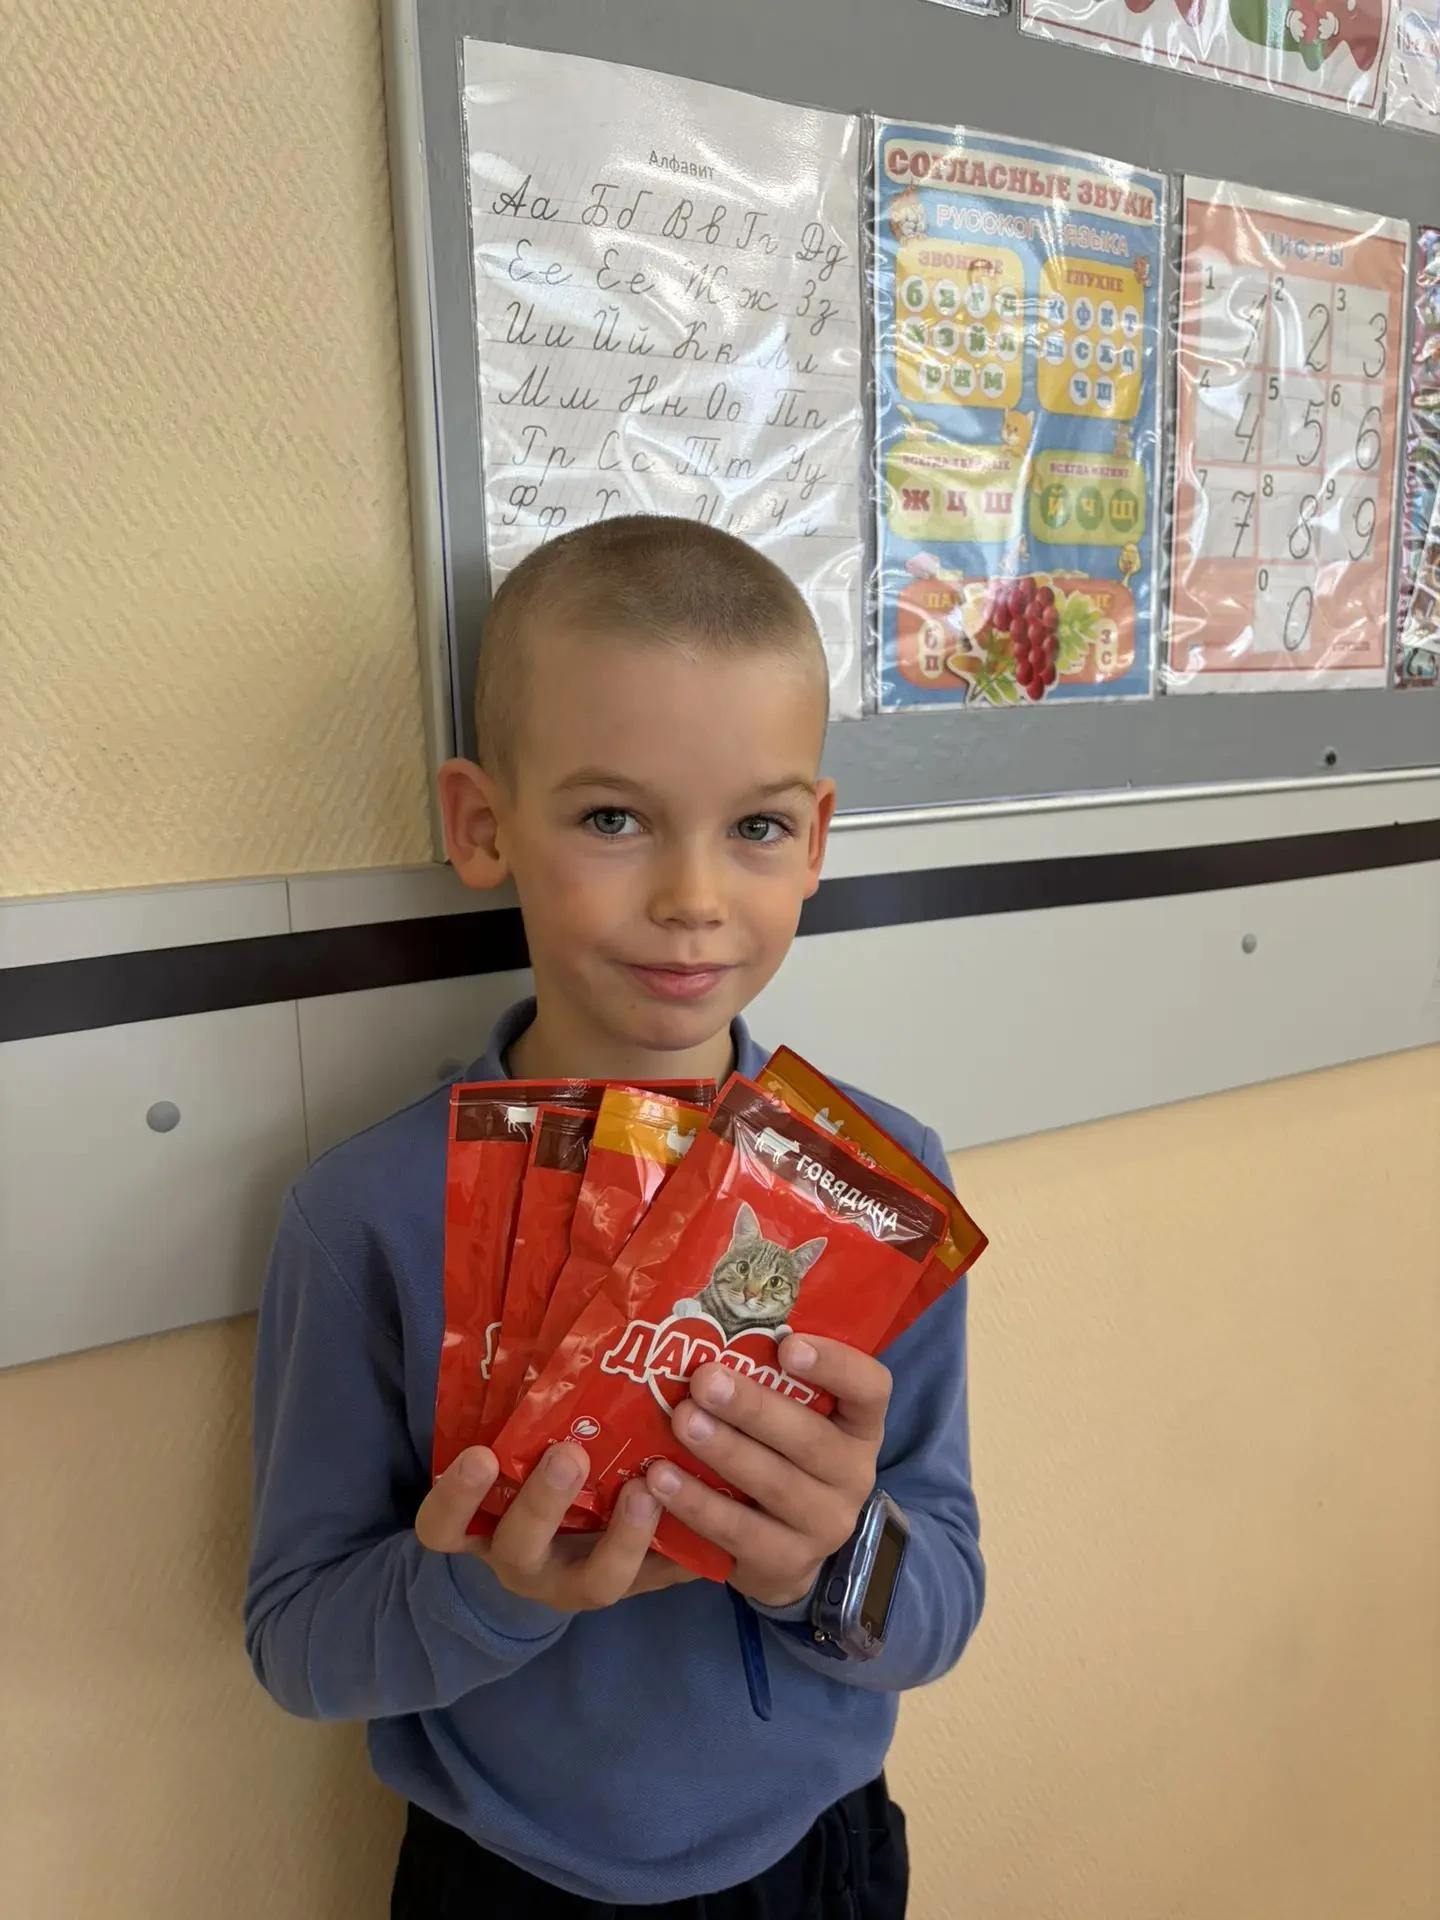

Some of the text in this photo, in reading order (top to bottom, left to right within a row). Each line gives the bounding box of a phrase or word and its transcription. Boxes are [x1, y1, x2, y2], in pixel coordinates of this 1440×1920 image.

[649, 150, 716, 180] Алфавит
[887, 147, 1155, 220] СОГЛАСНЫЕ ЗВУКИ
[919, 250, 1004, 275] ЗВОНЕ
[1063, 224, 1130, 257] ЯЗЫКА
[1205, 266, 1216, 290] 1
[1337, 288, 1346, 311] 3
[1306, 303, 1331, 372] 2
[1363, 313, 1388, 378] 3
[1269, 377, 1280, 400] 5
[1331, 384, 1341, 407] 6
[1235, 393, 1260, 463] 4
[1296, 400, 1325, 466] 5
[1355, 406, 1382, 471] 6
[902, 488, 930, 512] Ж
[1263, 474, 1274, 497] 8
[1326, 479, 1336, 500] 9
[1231, 490, 1256, 558] 7
[1289, 494, 1319, 559] 8
[1349, 497, 1377, 561] 9
[1258, 568, 1269, 591] 0
[1283, 586, 1314, 651] 0
[796, 1154, 898, 1232] ГОВЯДИНА
